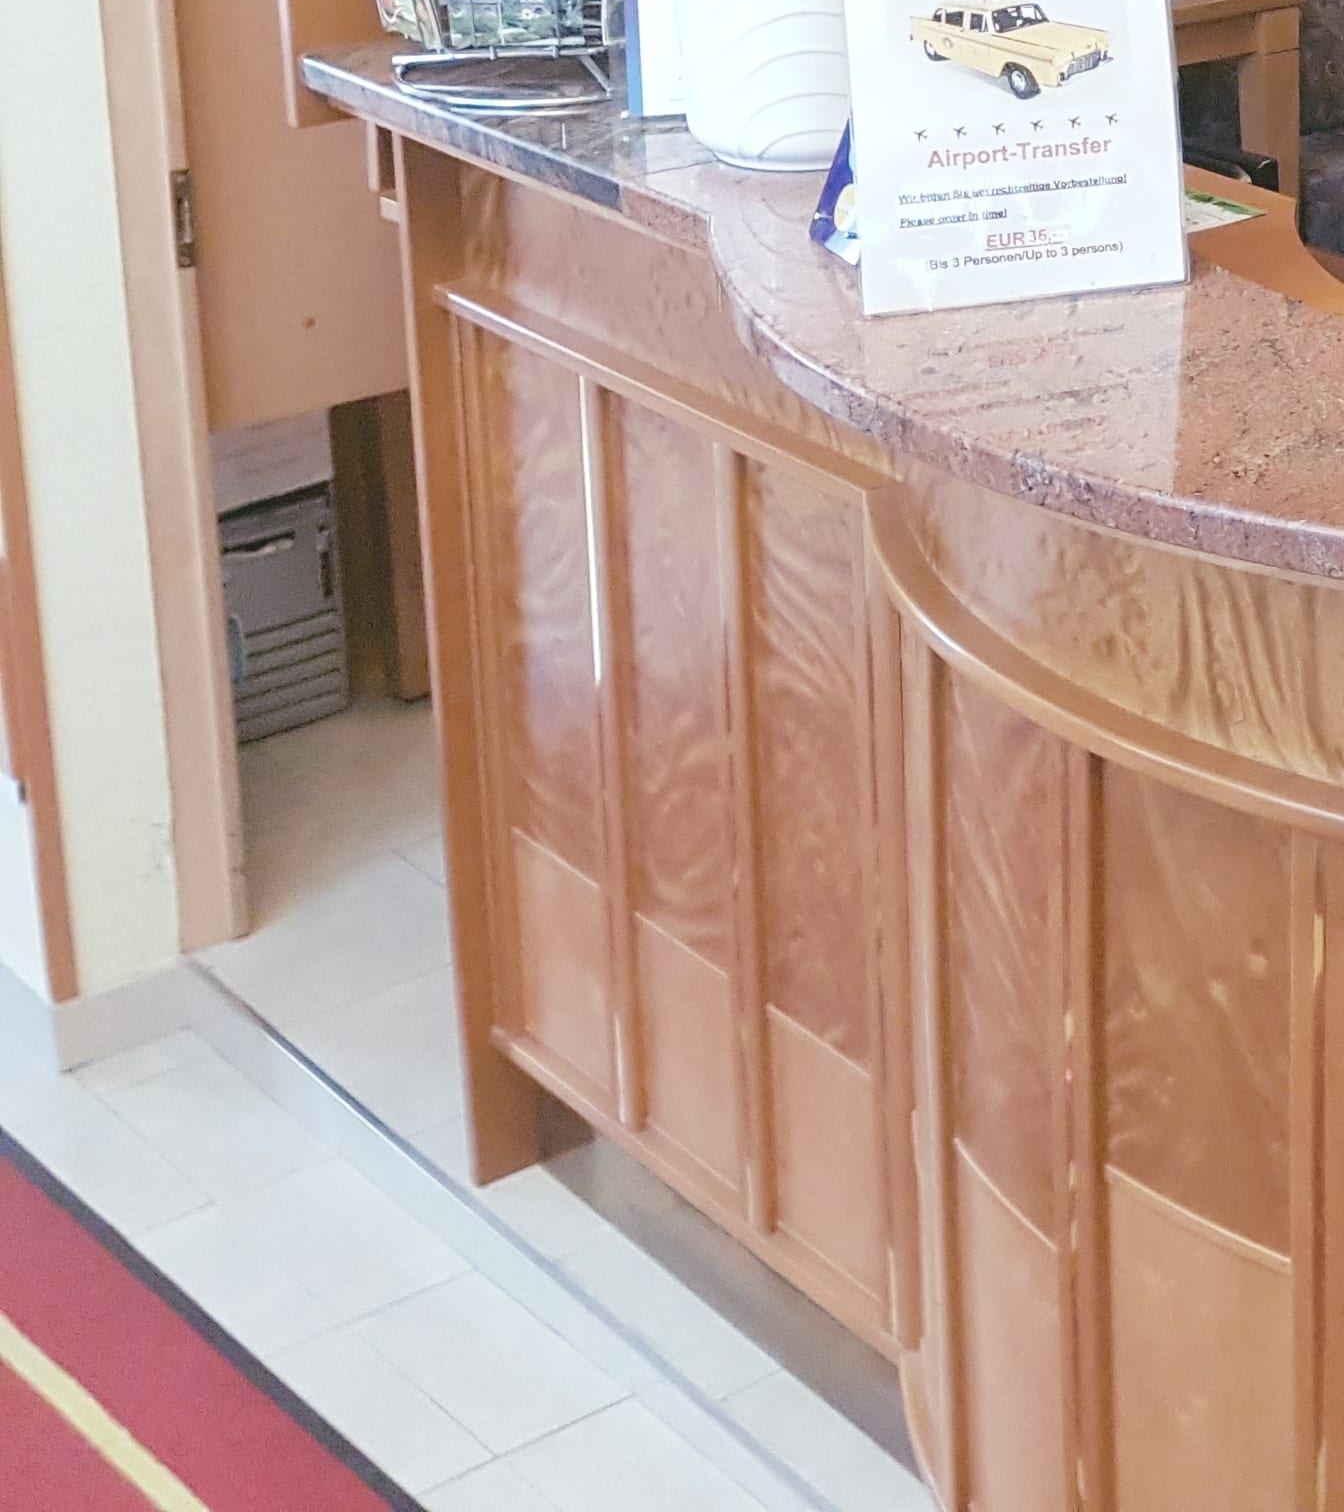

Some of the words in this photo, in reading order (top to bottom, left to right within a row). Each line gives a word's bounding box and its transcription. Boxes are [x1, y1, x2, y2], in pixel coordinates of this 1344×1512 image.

[927, 137, 1112, 170] Airport-Transfer
[898, 193, 916, 205] Wir
[1053, 173, 1128, 190] Vorbestellung!
[899, 216, 935, 229] Please
[952, 257, 961, 268] 3
[1046, 248, 1058, 259] to
[1060, 246, 1069, 257] 3
[1072, 240, 1124, 258] persons)
[986, 231, 1025, 249] EUR
